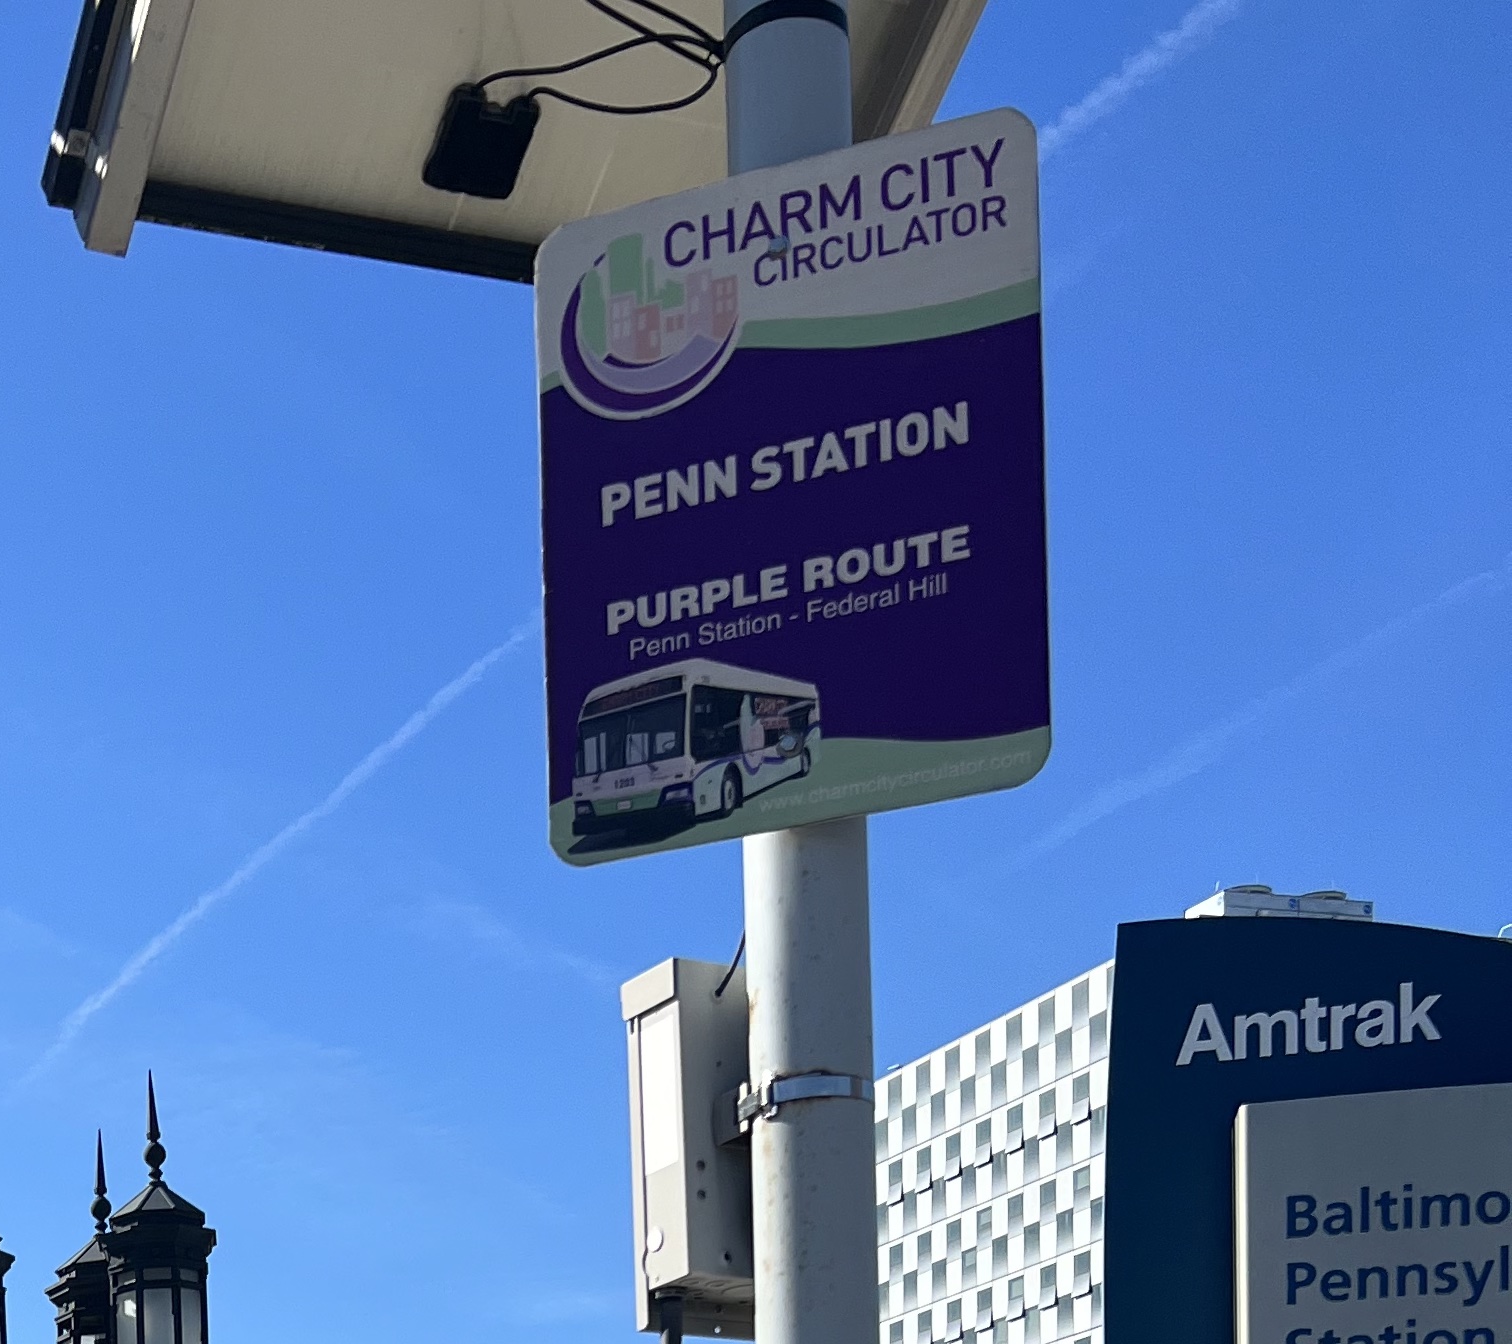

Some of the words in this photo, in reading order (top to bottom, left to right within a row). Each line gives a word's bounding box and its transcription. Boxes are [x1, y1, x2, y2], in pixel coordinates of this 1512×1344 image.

[663, 175, 863, 269] CHARM
[880, 138, 1007, 212] CITY
[752, 195, 1007, 286] CIRCULATOR
[599, 453, 739, 528] PENN
[749, 401, 970, 494] STATION
[605, 564, 788, 635] PURPLE
[803, 525, 972, 593] ROUTE
[628, 627, 691, 660] Penn
[697, 610, 783, 648] Station
[805, 583, 903, 624] Federal
[908, 573, 949, 605] Hill
[758, 748, 1034, 813] www.charmcitycirculator.com
[1175, 980, 1443, 1067] Amtrak
[1284, 1183, 1512, 1240] Baltimo
[1284, 1244, 1512, 1307] Pennsyl
